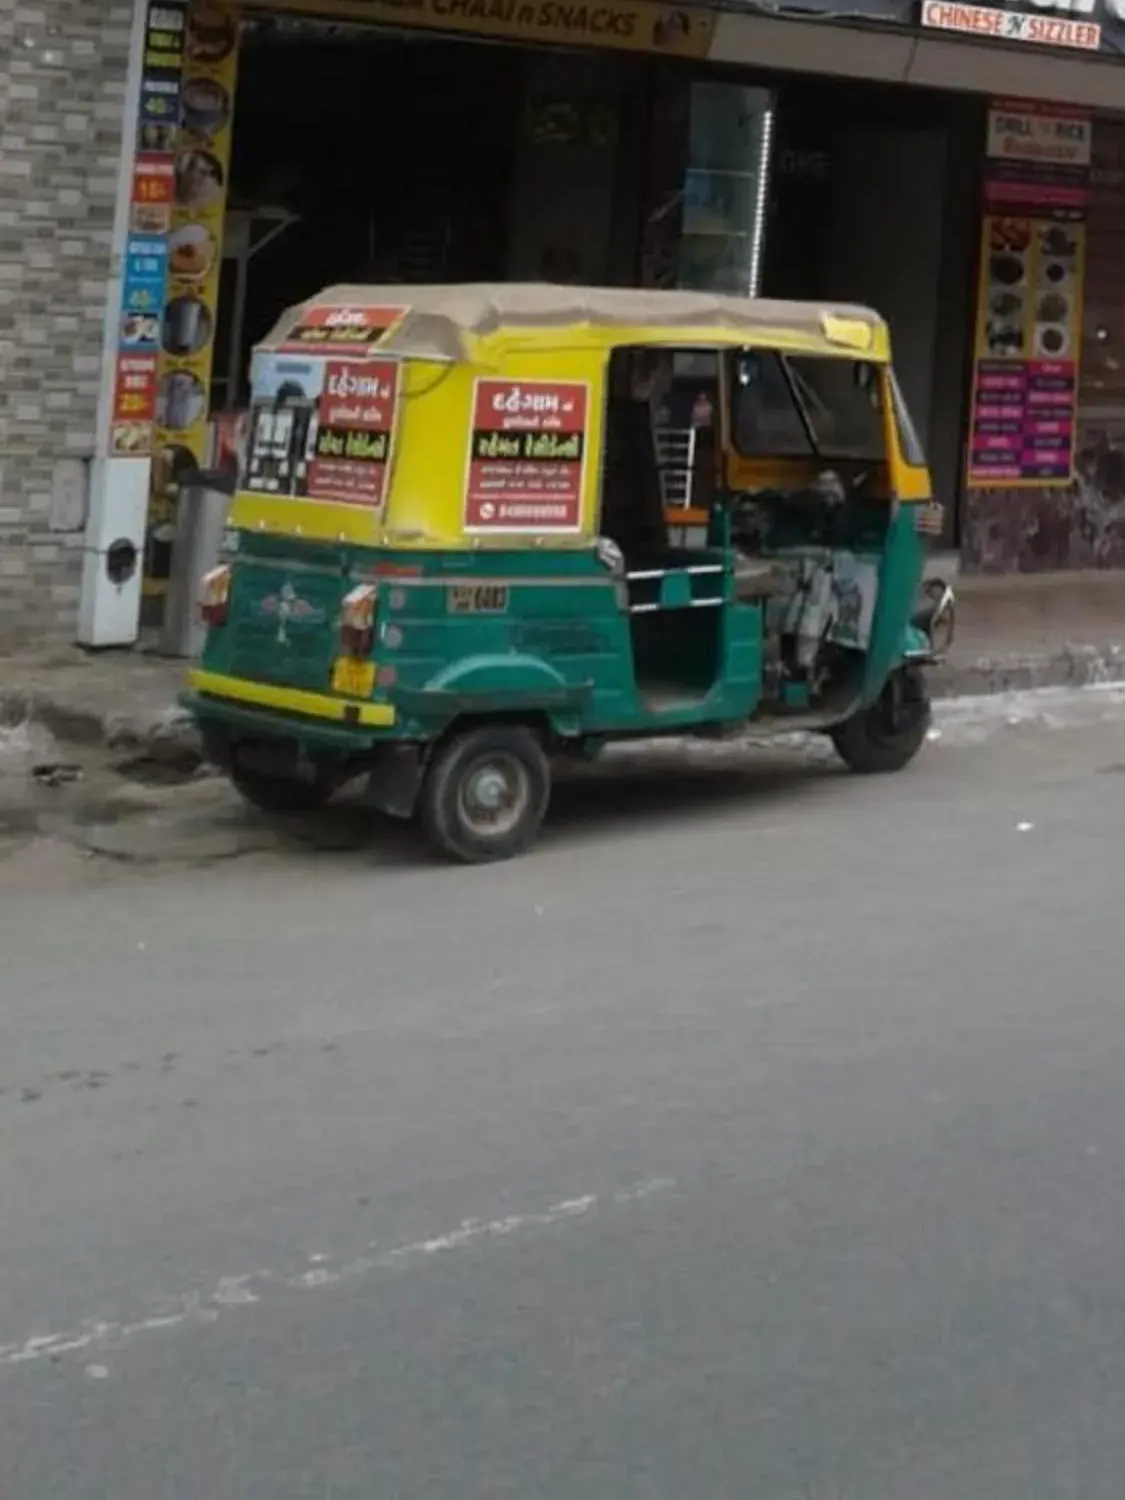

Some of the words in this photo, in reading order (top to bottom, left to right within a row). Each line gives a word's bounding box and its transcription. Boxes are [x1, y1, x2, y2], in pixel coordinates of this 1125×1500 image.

[537, 1, 640, 37] SNACKS
[926, 2, 1004, 36] CHINESE
[1028, 17, 1098, 47] SIZZLER
